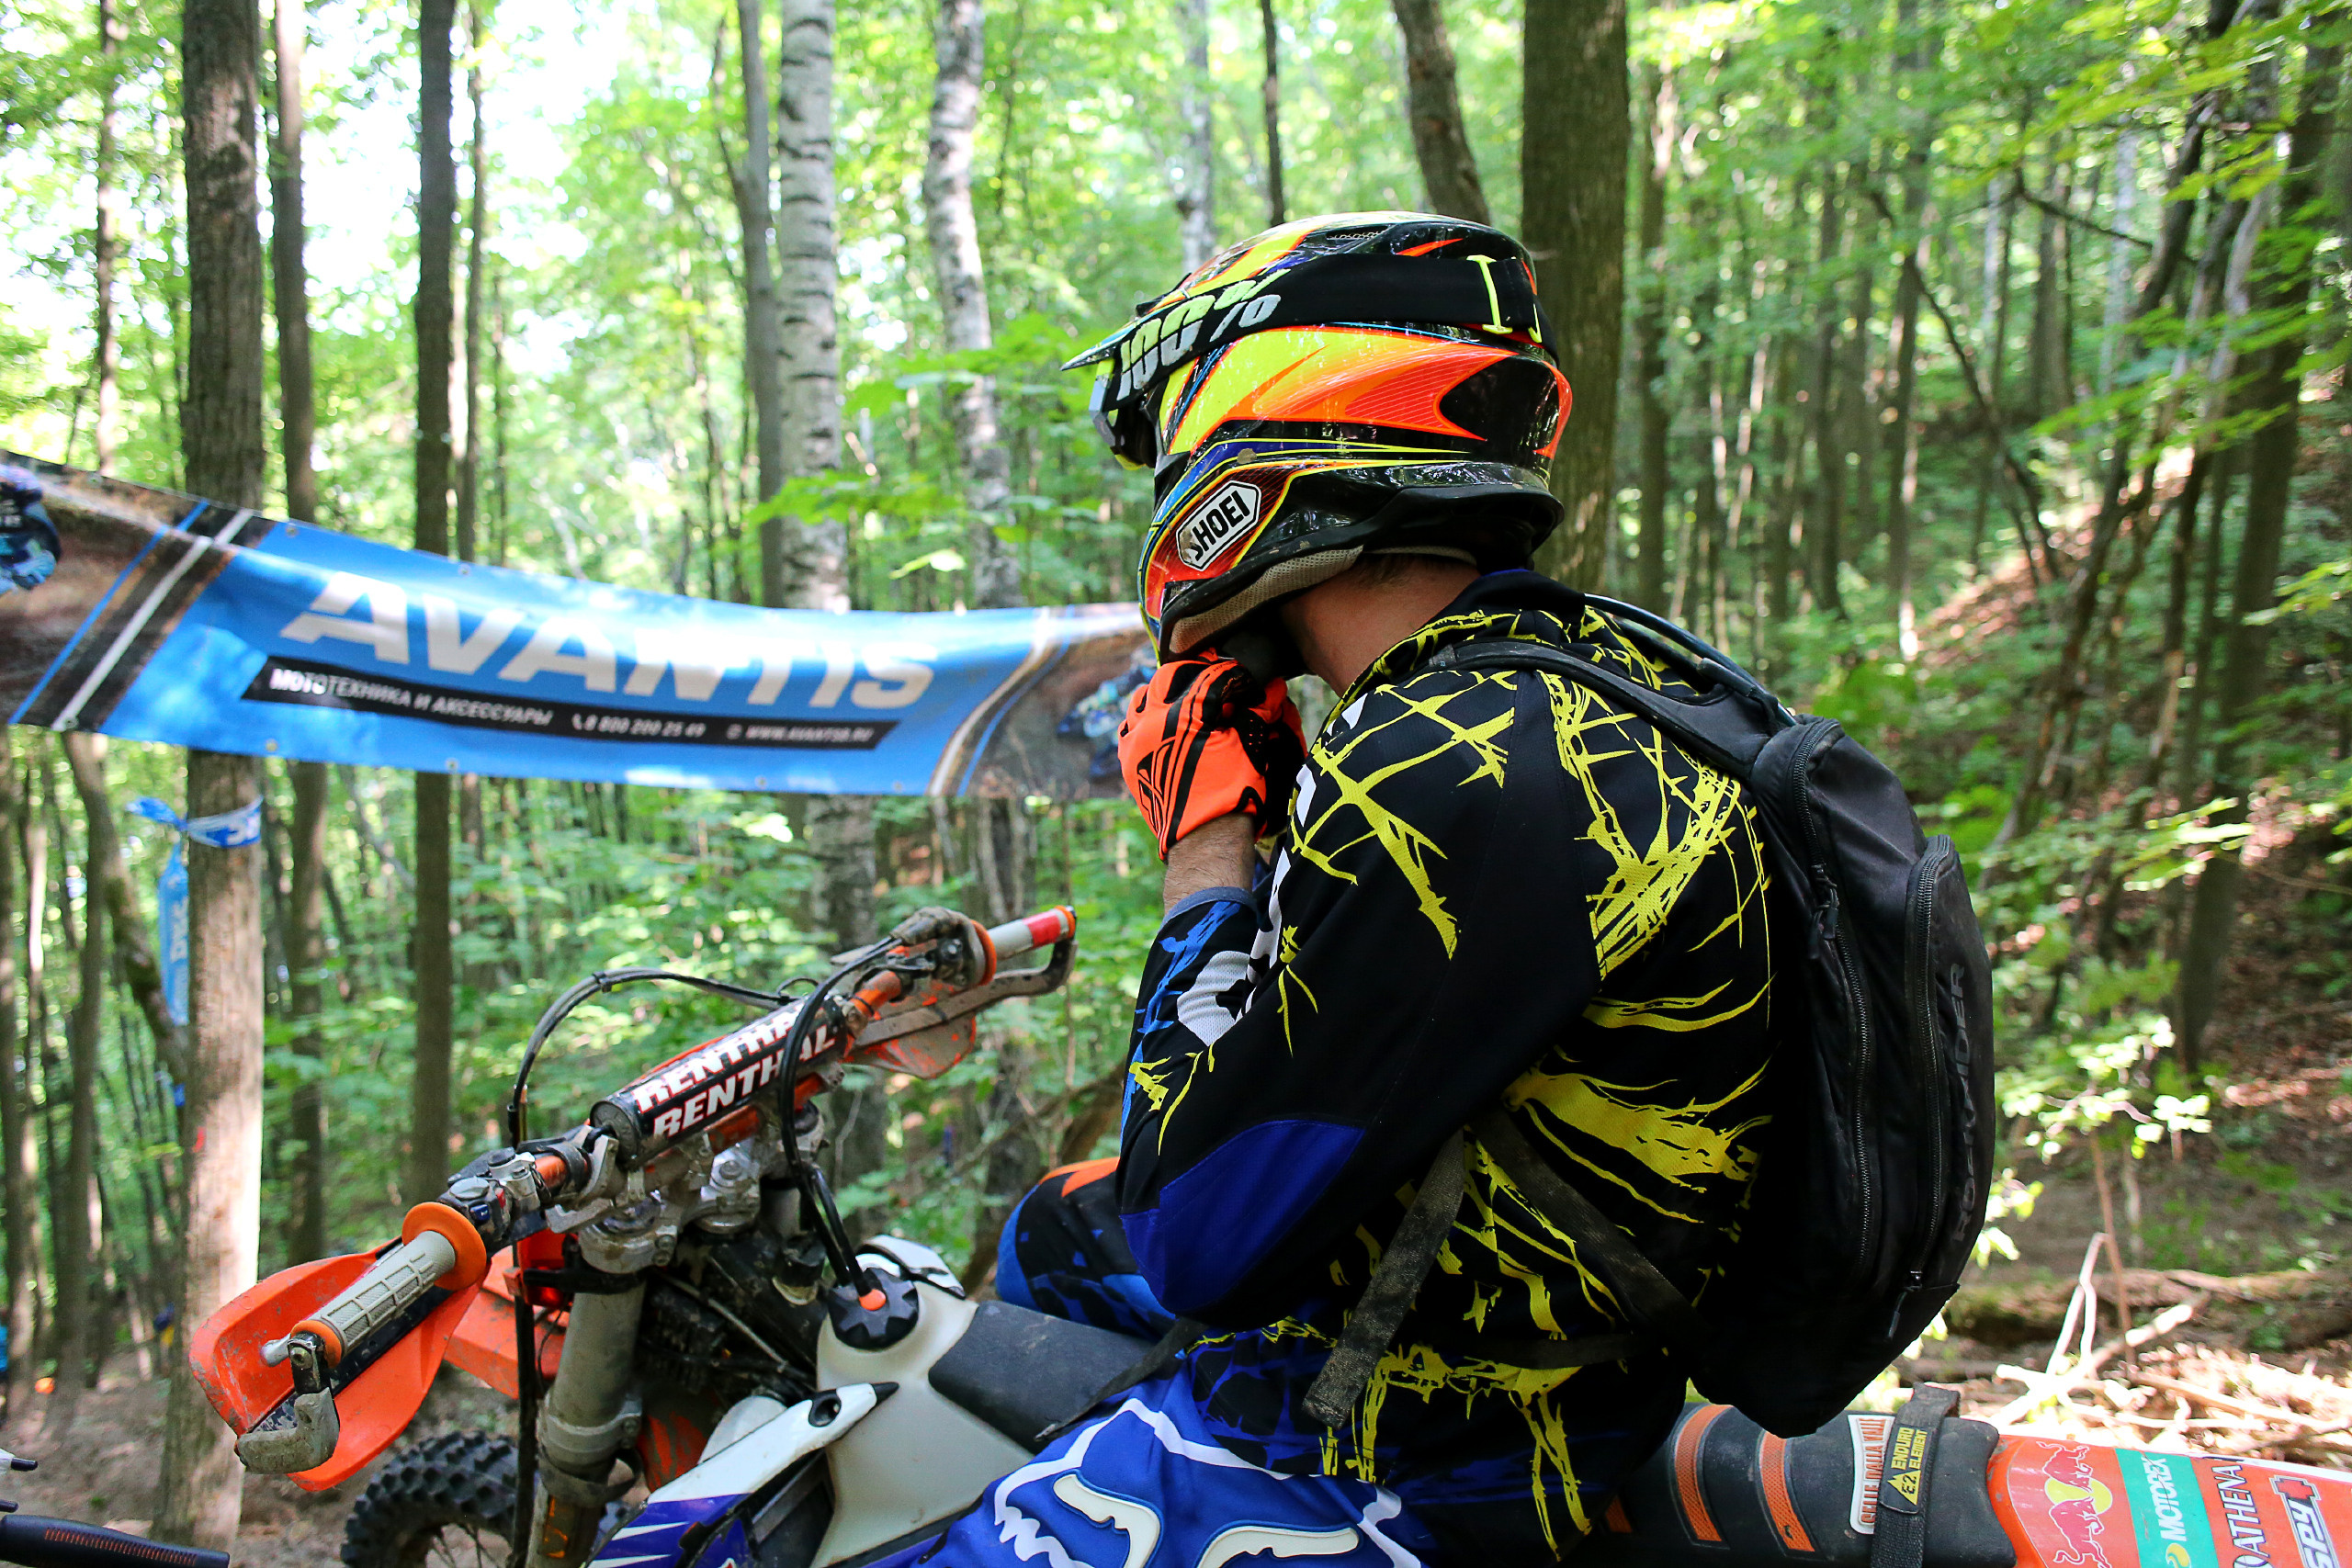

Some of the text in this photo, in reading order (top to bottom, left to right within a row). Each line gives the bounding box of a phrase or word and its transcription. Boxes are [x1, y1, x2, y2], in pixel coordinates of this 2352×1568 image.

[1116, 268, 1292, 401] 100%
[1187, 490, 1251, 562] SHOEI
[280, 570, 939, 709] AVANTIS
[268, 667, 554, 727] МОТОТЕХНИКА И АКСЕССУАРЫ
[631, 1001, 820, 1114] RENTHA
[1890, 1426, 1915, 1471] ENDURO
[1908, 1428, 1928, 1470] ELEMENT
[2141, 1455, 2188, 1542] MOTOREX
[2211, 1464, 2271, 1558] ATHENA
